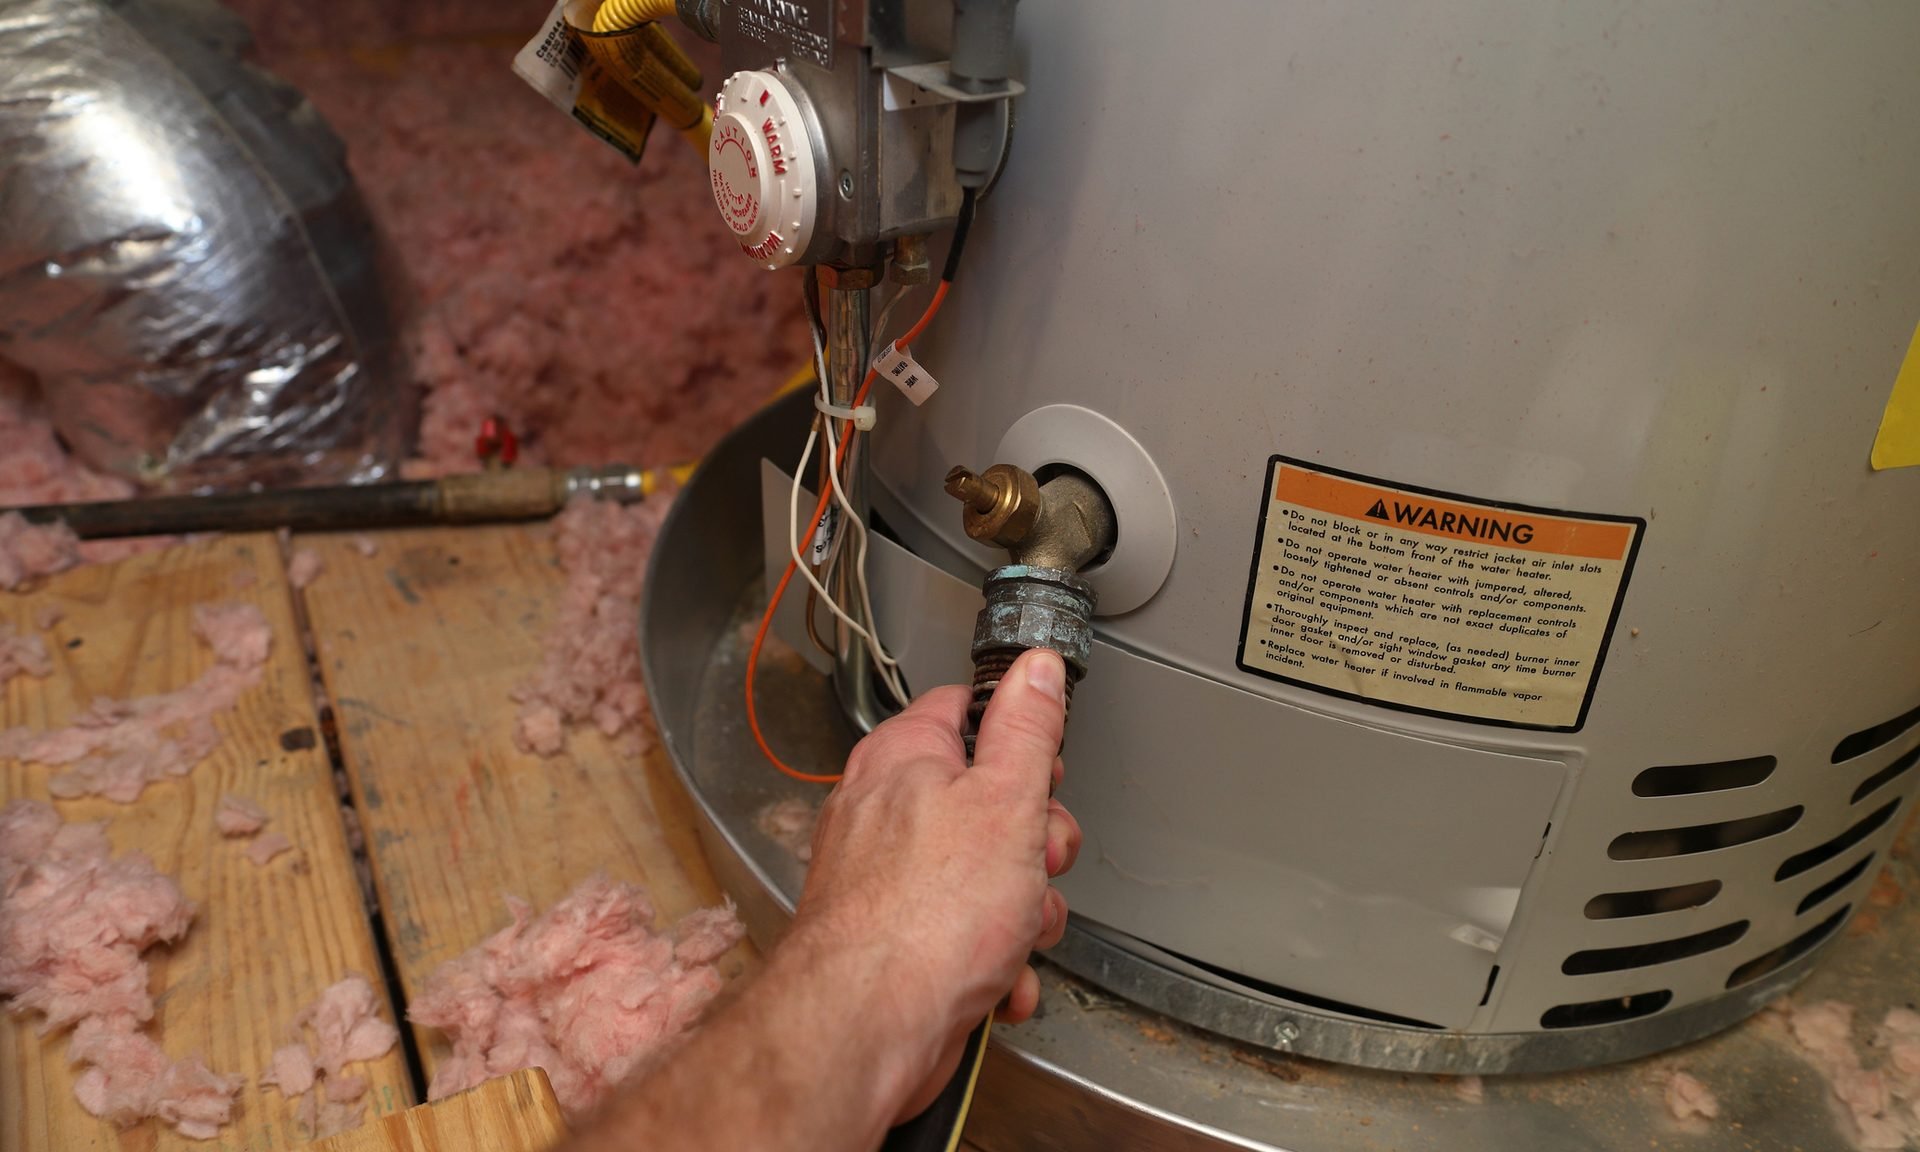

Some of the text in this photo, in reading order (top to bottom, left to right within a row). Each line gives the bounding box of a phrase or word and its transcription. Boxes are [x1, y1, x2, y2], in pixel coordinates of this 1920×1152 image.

[714, 126, 757, 178] CAUTION
[762, 117, 786, 176] WARM
[740, 231, 783, 260] VACATION
[1288, 522, 1552, 581] located at the bottom front of the water heater.
[1291, 510, 1602, 574] Do not block or in any way restrict jacket air inlet slots
[1394, 502, 1534, 545] WARNING
[1281, 566, 1577, 629] Do not operate water heater with replacement controls
[1283, 549, 1587, 613] loosely tightened or absent controls and/or components.
[1285, 538, 1573, 600] Do not operate water heater with jumpered, altered,
[1276, 589, 1375, 620] original equipment.
[1279, 578, 1568, 639] and/or components which are not exact duplicates of
[1265, 650, 1305, 669] incident.
[1270, 625, 1456, 675] inner door is removed or disturbed.
[1271, 615, 1577, 678] door gasket and/or sight window gasket any time burner
[1274, 603, 1580, 667] Thoroughly inspect and replace, (as needed) burner inner
[1267, 640, 1543, 702] Replace water heater if involved in flammable vapor
